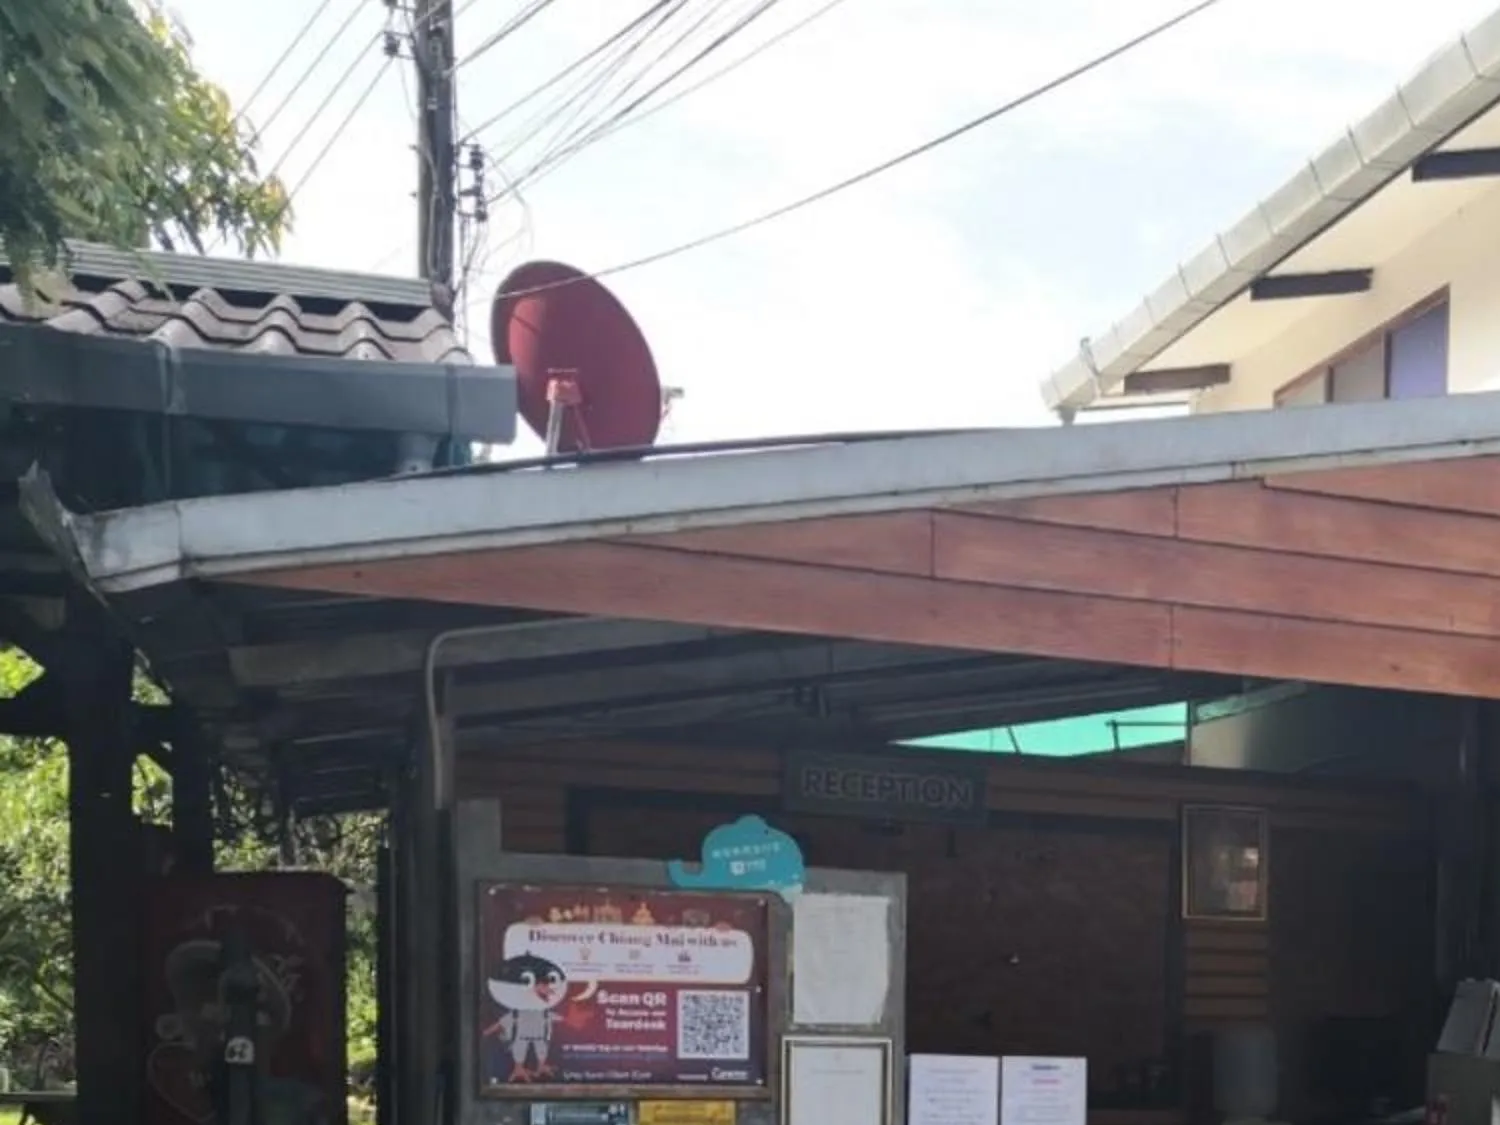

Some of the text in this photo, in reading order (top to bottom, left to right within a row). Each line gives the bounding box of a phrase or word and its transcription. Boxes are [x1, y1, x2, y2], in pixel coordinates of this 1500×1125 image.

[802, 765, 975, 809] RECEPTION
[529, 929, 595, 944] Discover
[598, 931, 652, 948] Chiang
[656, 932, 685, 948] Mai
[686, 933, 719, 948] with
[597, 990, 667, 1008] Scan QR
